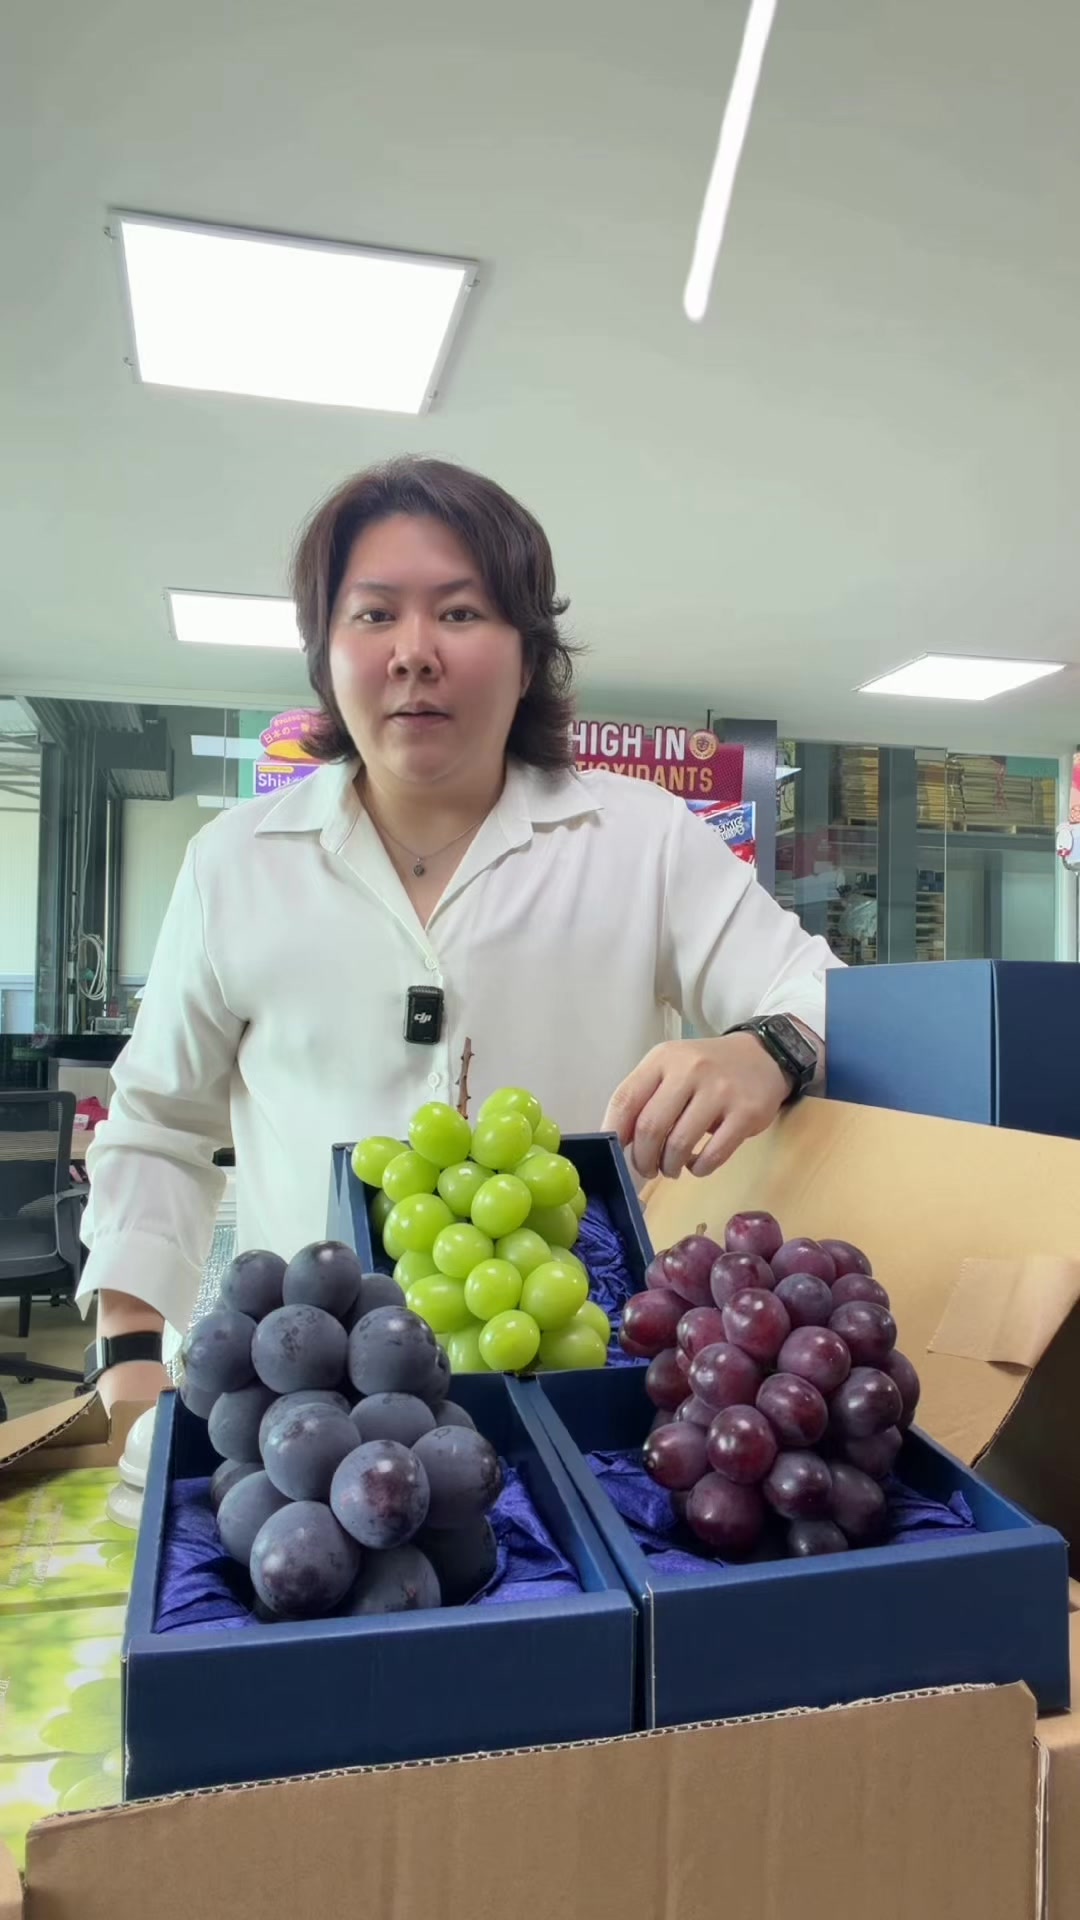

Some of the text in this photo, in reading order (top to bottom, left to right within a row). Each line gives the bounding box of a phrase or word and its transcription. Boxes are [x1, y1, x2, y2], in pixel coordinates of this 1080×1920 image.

[569, 722, 643, 758] HIGH
[654, 726, 686, 761] IN
[718, 816, 744, 834] SMIC
